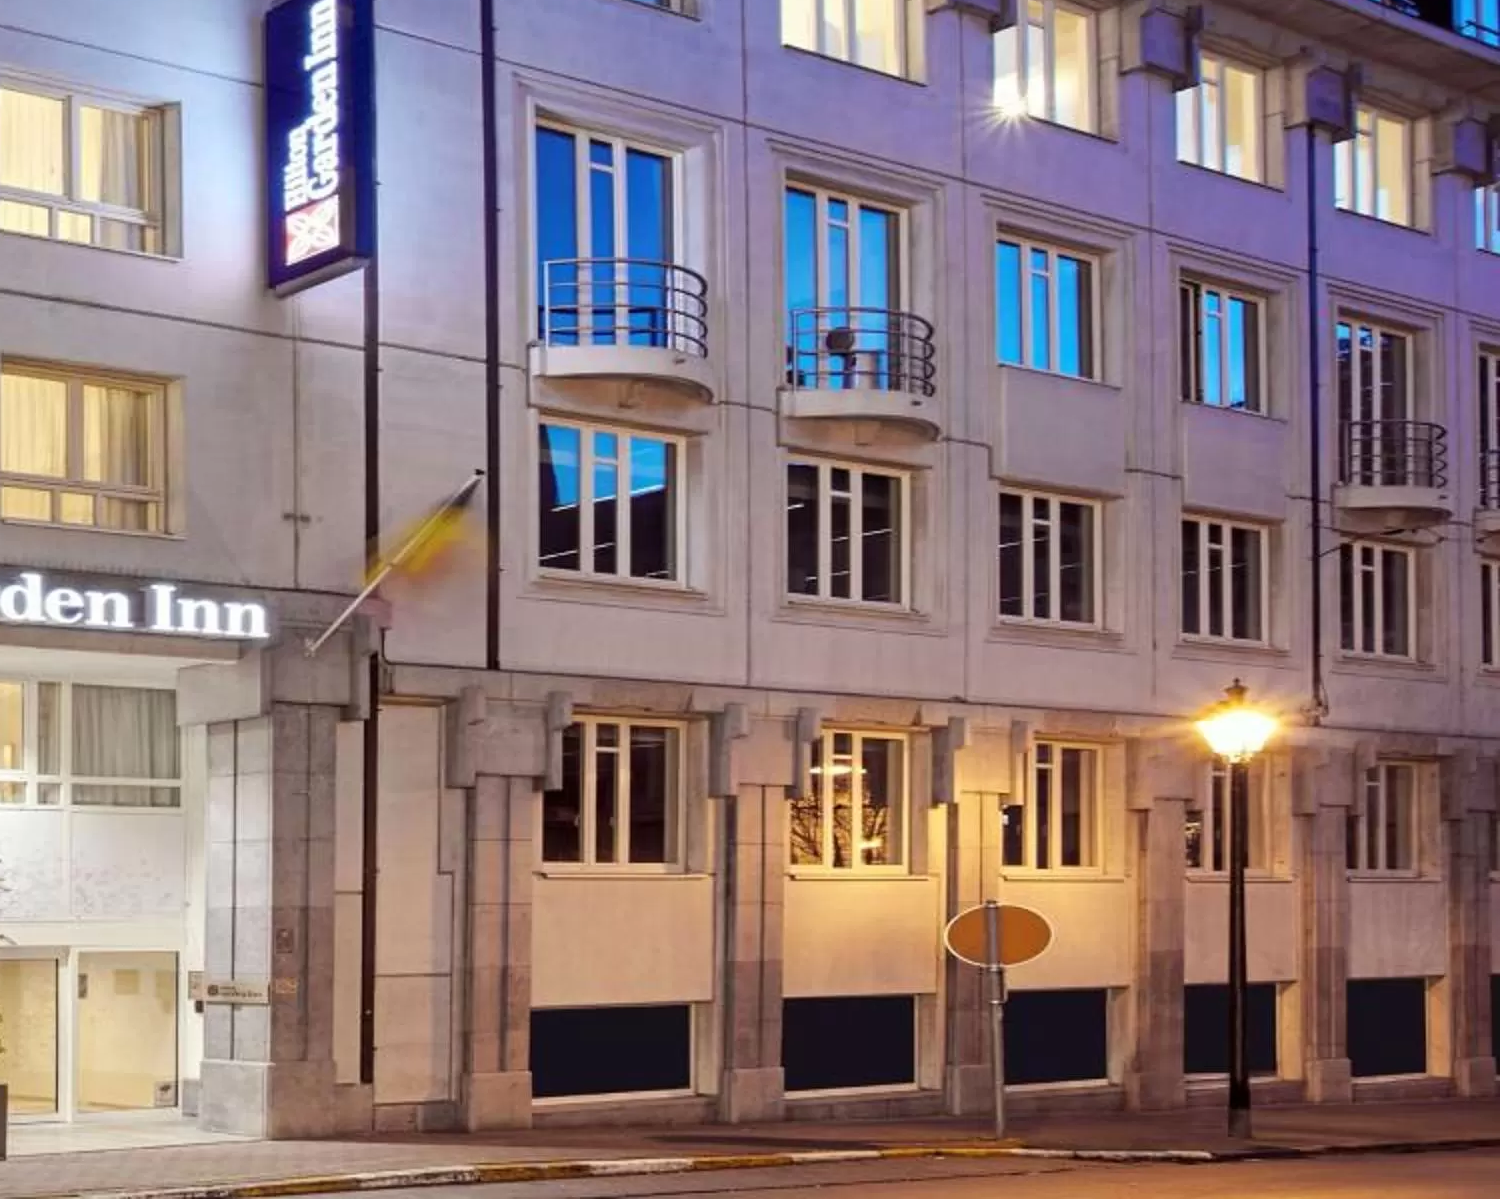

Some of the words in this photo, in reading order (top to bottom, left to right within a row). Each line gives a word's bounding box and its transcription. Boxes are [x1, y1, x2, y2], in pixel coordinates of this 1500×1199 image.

[284, 124, 308, 212] Hilton
[306, 61, 338, 200] Garden
[149, 583, 271, 639] Inn
